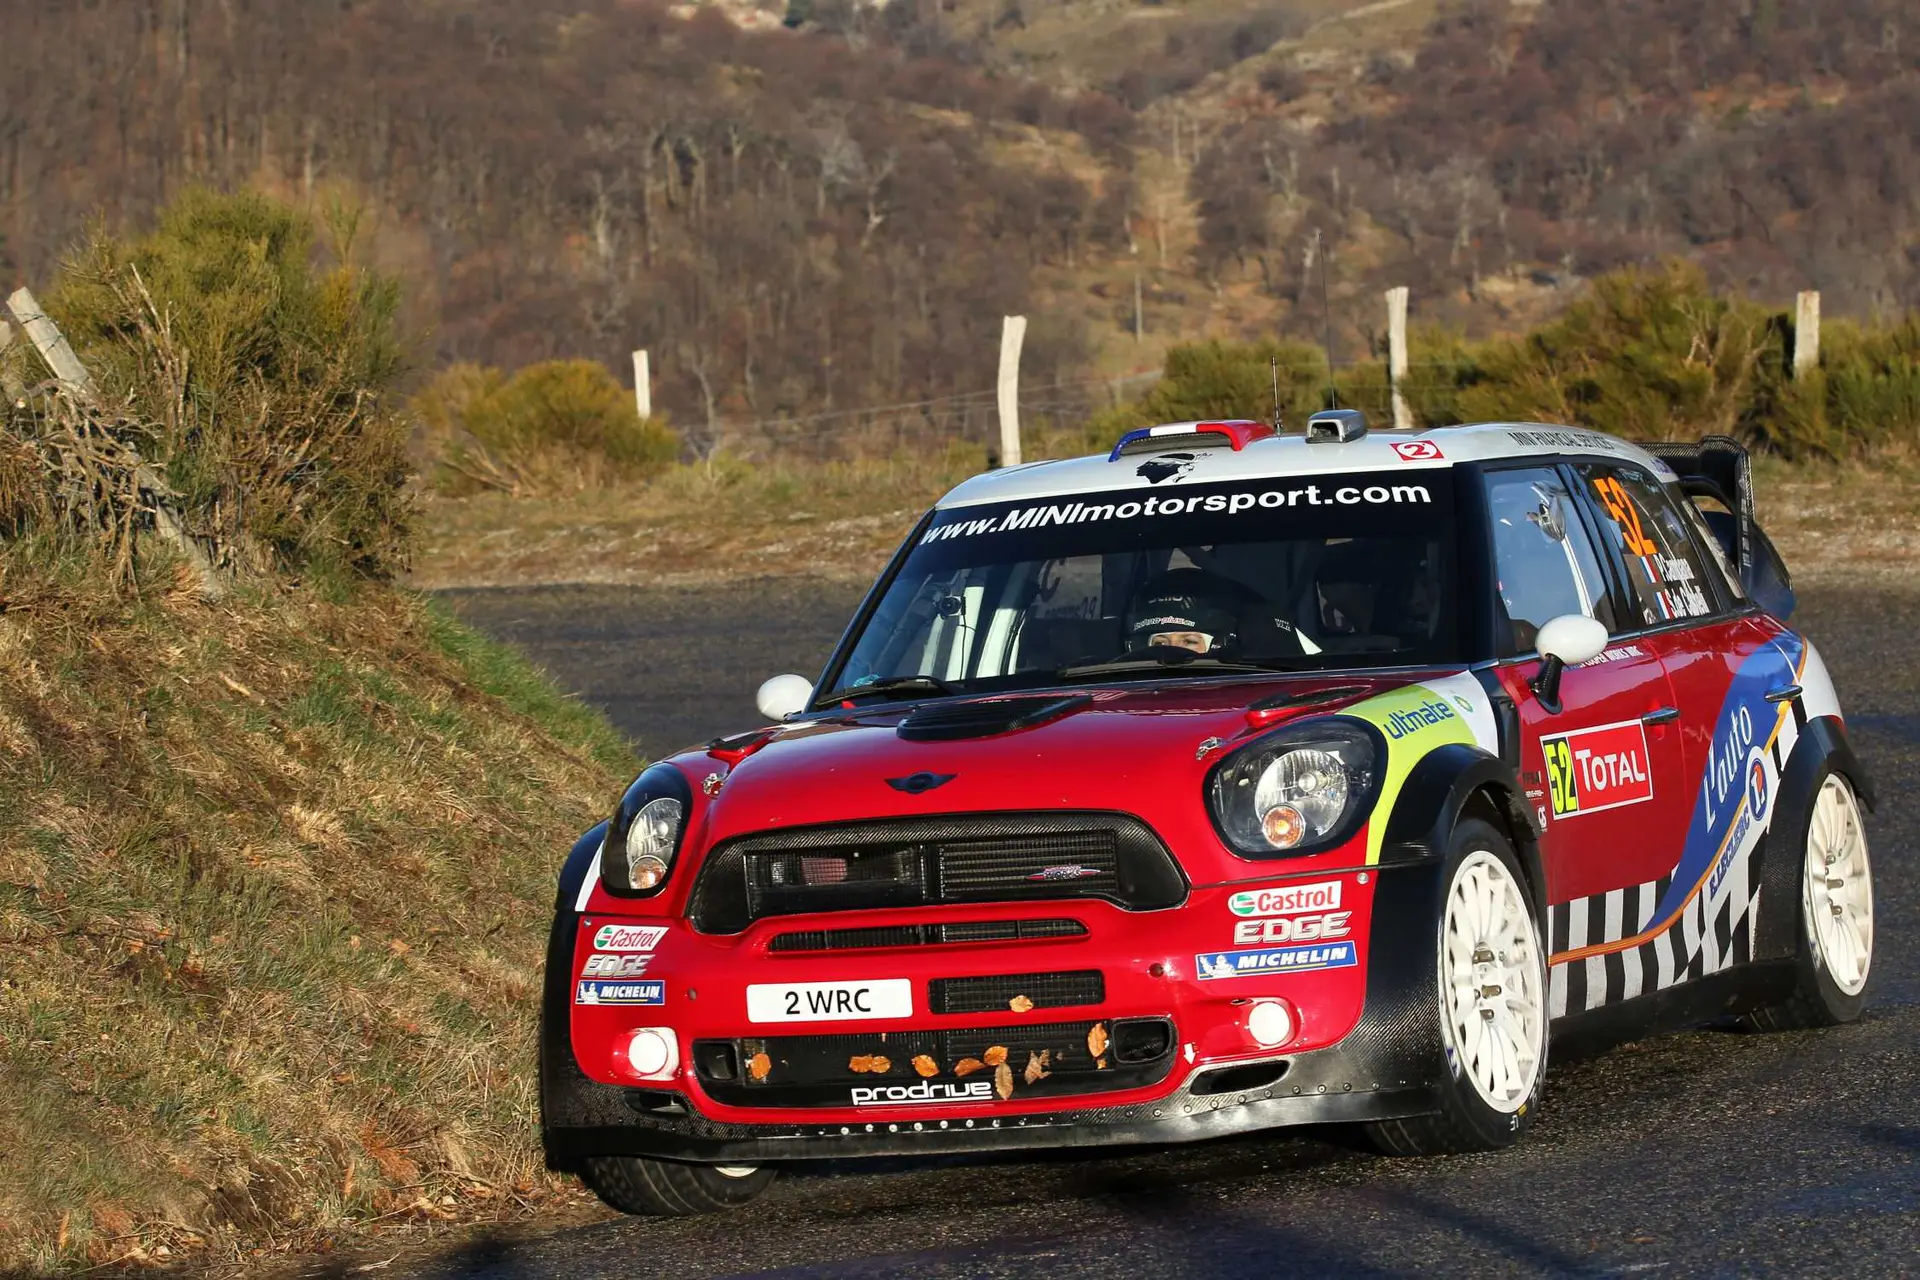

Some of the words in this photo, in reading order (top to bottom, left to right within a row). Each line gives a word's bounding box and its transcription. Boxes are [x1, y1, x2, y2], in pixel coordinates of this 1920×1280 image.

[1403, 443, 1430, 456] 2
[919, 482, 1432, 546] www.MINImotorsport.com
[1593, 476, 1657, 557] 52
[1383, 700, 1455, 740] ultimate
[1546, 740, 1578, 815] 52
[1255, 886, 1336, 913] Castrol
[608, 927, 661, 949] Castrol
[1233, 911, 1352, 946] EDGE
[580, 953, 656, 979] EDGE
[1236, 945, 1349, 970] MICHELIN
[600, 984, 661, 999] MICHELIN
[785, 991, 801, 1015] 2
[806, 988, 872, 1014] WRC
[850, 1080, 993, 1106] prodrive
